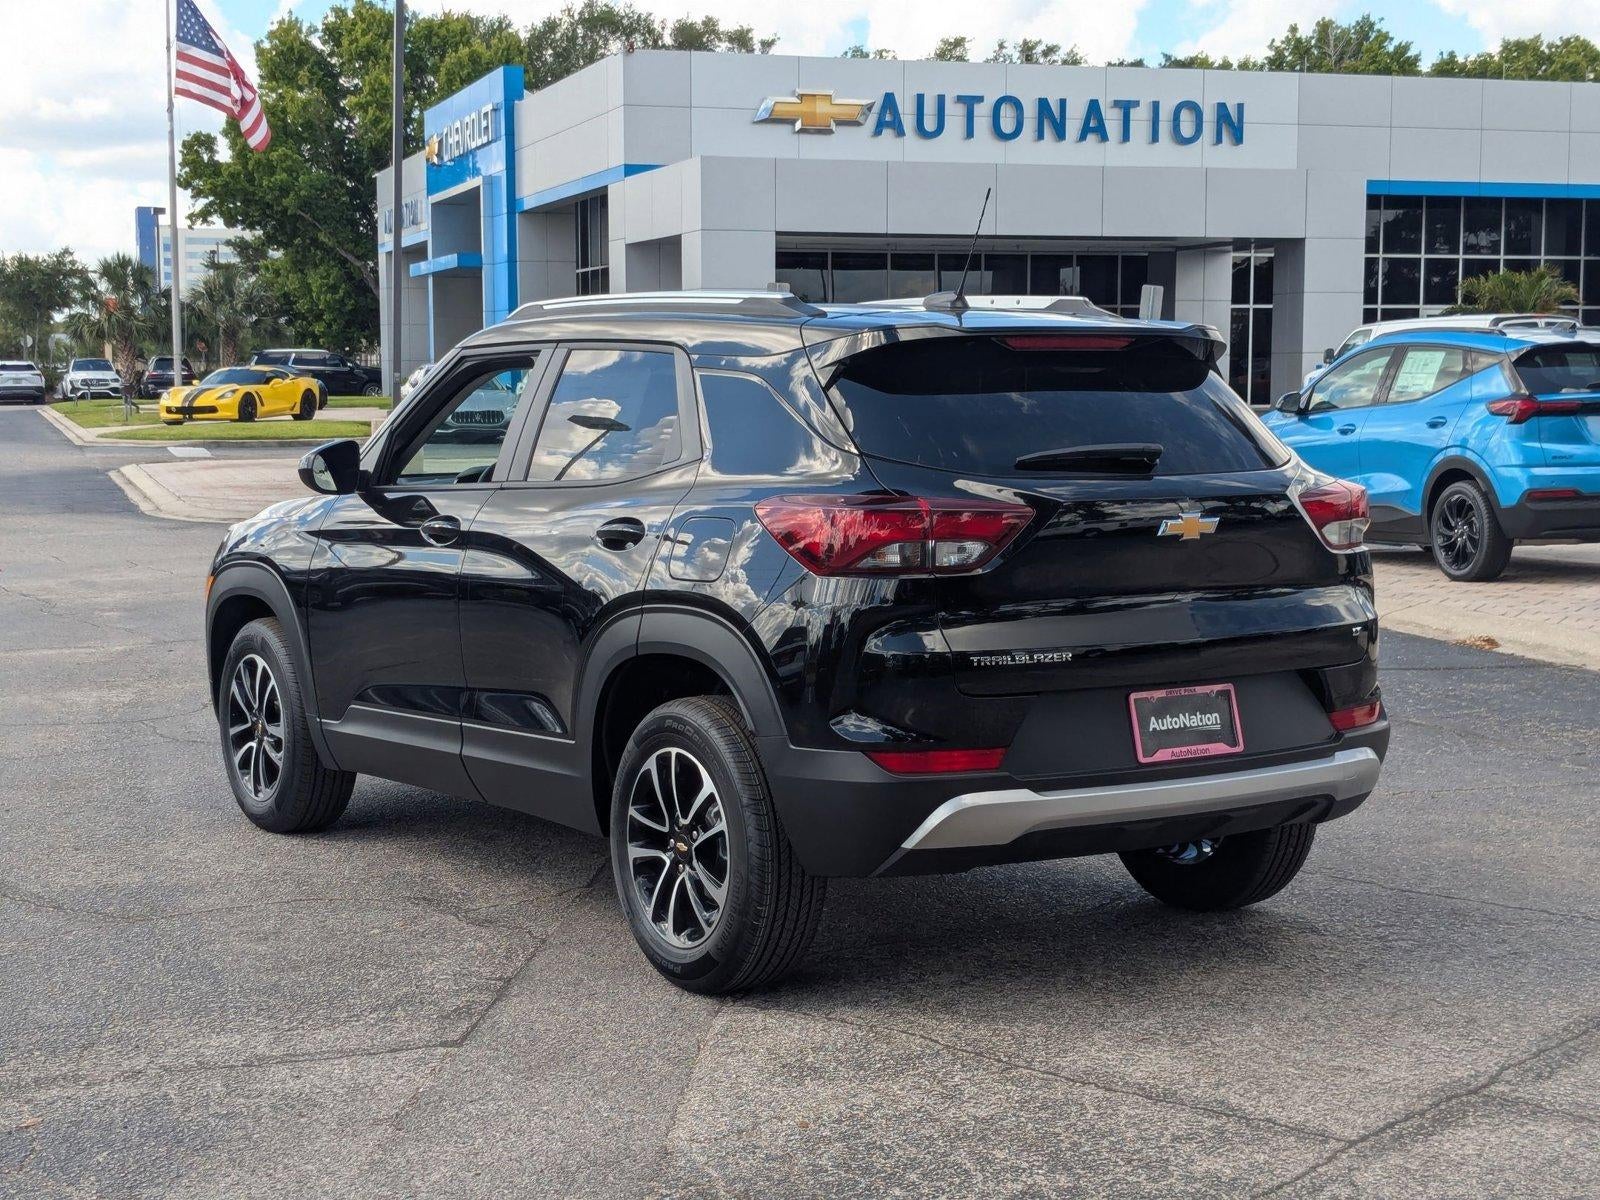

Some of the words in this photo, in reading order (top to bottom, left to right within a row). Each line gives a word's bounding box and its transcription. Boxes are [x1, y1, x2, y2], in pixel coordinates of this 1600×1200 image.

[873, 91, 1246, 146] AUTONATION
[442, 102, 493, 161] CHEVROLET
[969, 651, 1073, 667] TRAILBLAZER
[1149, 711, 1221, 731] AutoNation
[1170, 746, 1211, 759] AutoNation
